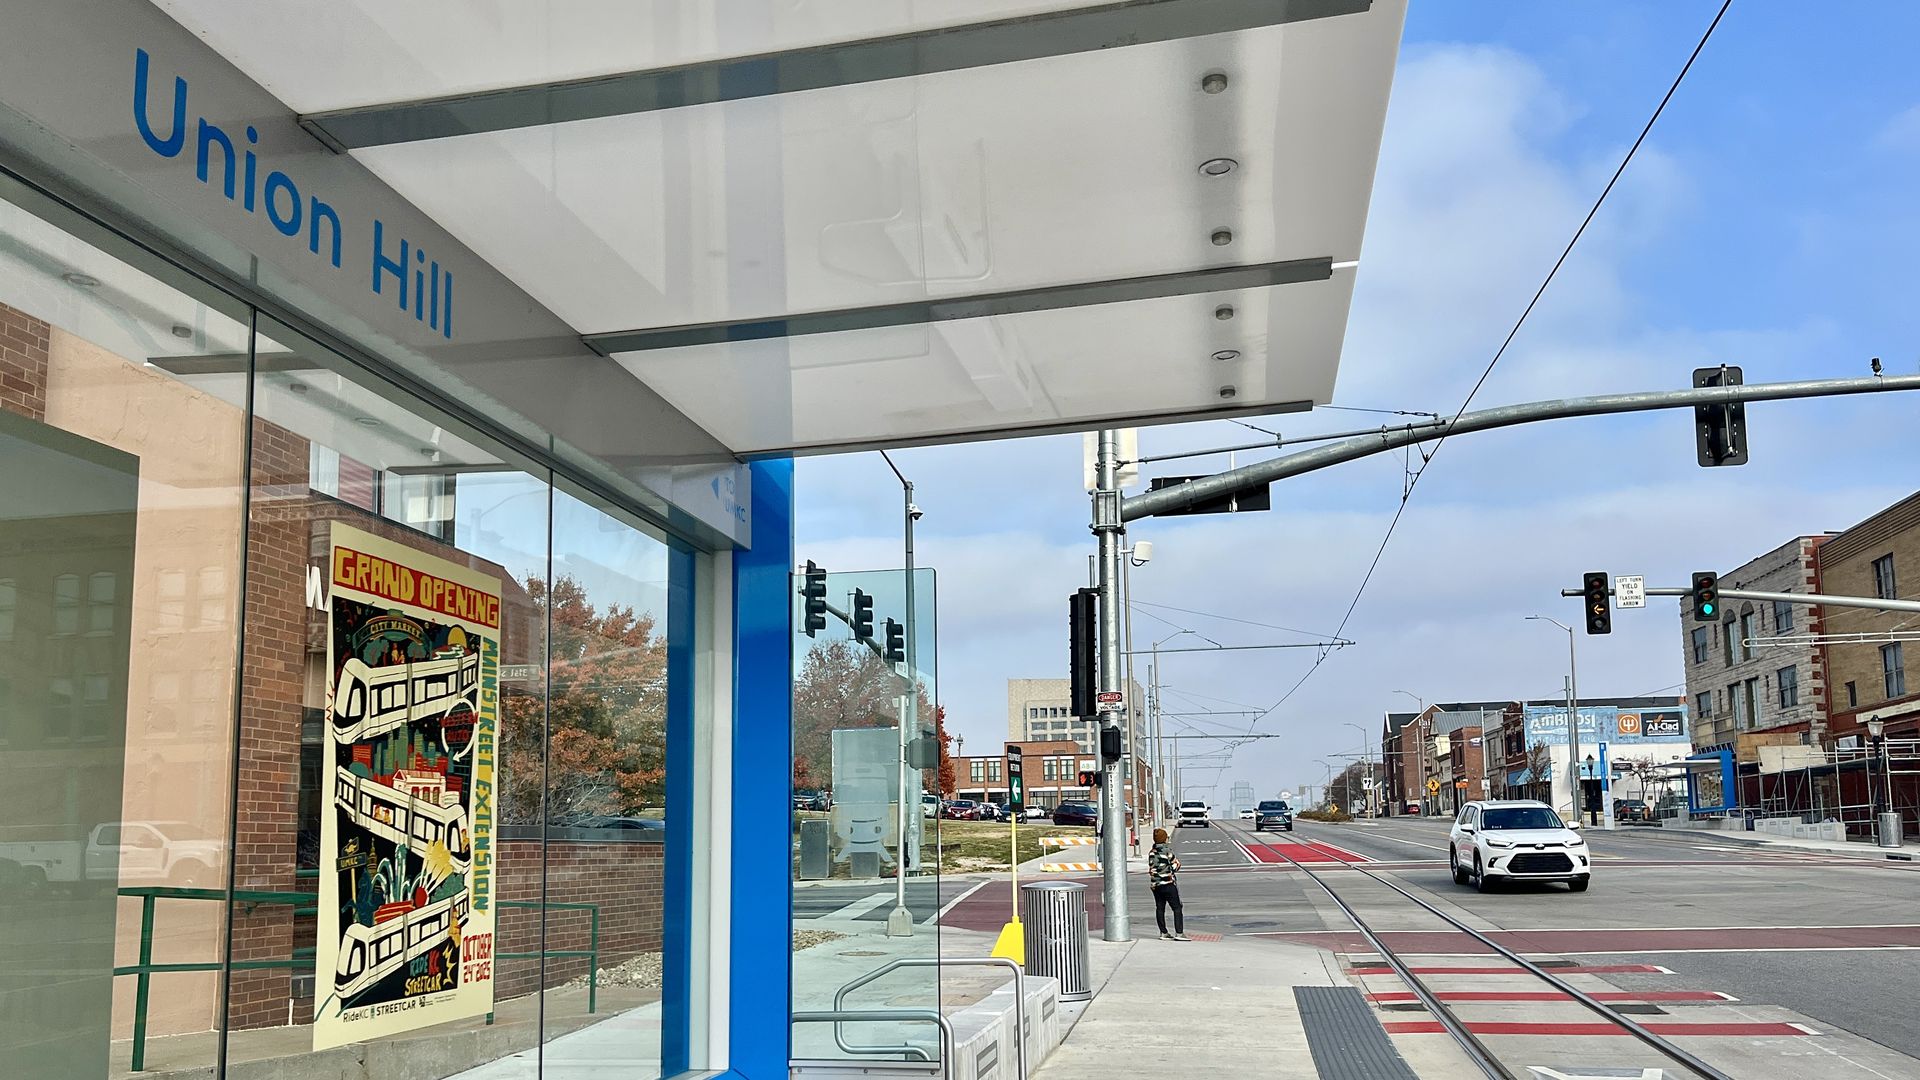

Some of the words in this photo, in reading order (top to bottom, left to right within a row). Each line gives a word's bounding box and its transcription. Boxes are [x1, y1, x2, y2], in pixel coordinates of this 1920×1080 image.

[133, 48, 342, 268] Union
[373, 219, 452, 339] Hill
[335, 549, 414, 602] GRAND
[420, 575, 498, 627] OPENING
[371, 621, 388, 634] CITY
[391, 620, 421, 638] MARKET
[474, 777, 492, 910] EXTENSION
[463, 933, 492, 963] OCTOBER
[404, 973, 442, 996] STREETCAR
[343, 1008, 369, 1023] RideKC
[376, 1000, 416, 1017] STREETCAR
